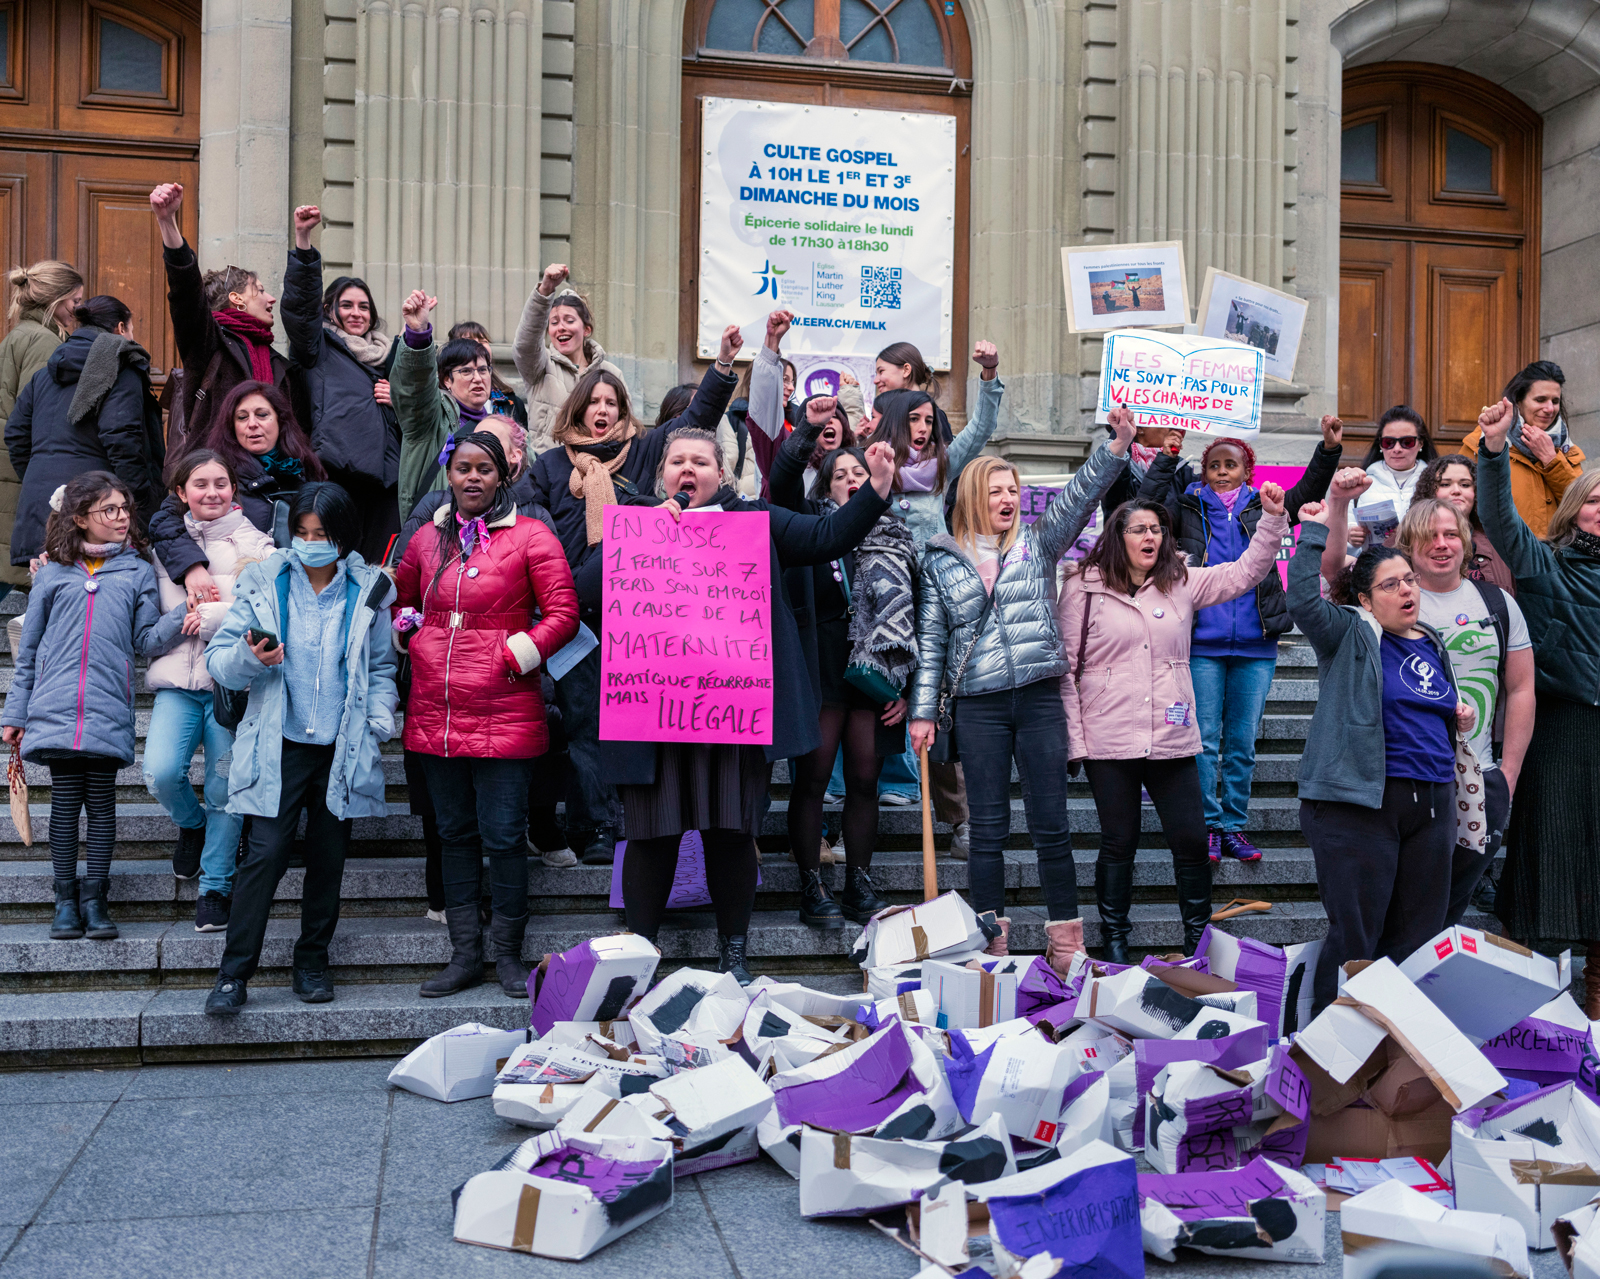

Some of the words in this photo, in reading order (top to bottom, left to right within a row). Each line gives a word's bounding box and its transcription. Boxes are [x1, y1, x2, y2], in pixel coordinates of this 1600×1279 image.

[764, 143, 821, 162] CULTE
[826, 148, 898, 167] GOSPEL
[749, 161, 762, 179] À
[768, 167, 802, 182] 10H
[808, 169, 830, 184] LE
[836, 171, 861, 185] 1ER
[866, 174, 888, 188] ET
[894, 175, 912, 190] 3E
[740, 186, 838, 207] DIMANCHE
[843, 194, 869, 209] DU
[874, 196, 920, 212] MOIS
[744, 212, 800, 231] Épicerie
[804, 219, 861, 234] solidaire
[866, 223, 877, 235] le
[881, 224, 914, 237] lundi
[769, 234, 786, 246] de
[791, 235, 834, 249] 17h30
[816, 271, 844, 280] Martin
[816, 281, 844, 290] Luther
[816, 291, 836, 302] King
[791, 316, 887, 331] W.EERV.CH/EMLK
[1119, 350, 1162, 370] LES
[1189, 359, 1256, 384] FEMMES
[1112, 368, 1130, 383] NE
[1136, 370, 1177, 387] SONT
[1184, 376, 1208, 392] PAS
[1210, 378, 1249, 398] POUR
[1152, 390, 1209, 410] CHAMPS
[1212, 399, 1233, 411] DE
[611, 513, 642, 541] EN
[608, 546, 626, 573] 1
[630, 554, 682, 574] FEMME
[692, 562, 728, 578] SUR
[738, 562, 758, 582] 7
[608, 576, 654, 592] PERD
[664, 578, 698, 595] SON
[608, 600, 622, 617] A
[632, 602, 689, 618] CAUSE
[702, 605, 726, 621] DE
[740, 608, 763, 630] LA
[698, 670, 772, 690] RÉCURRENTE
[606, 691, 649, 706] MAIS
